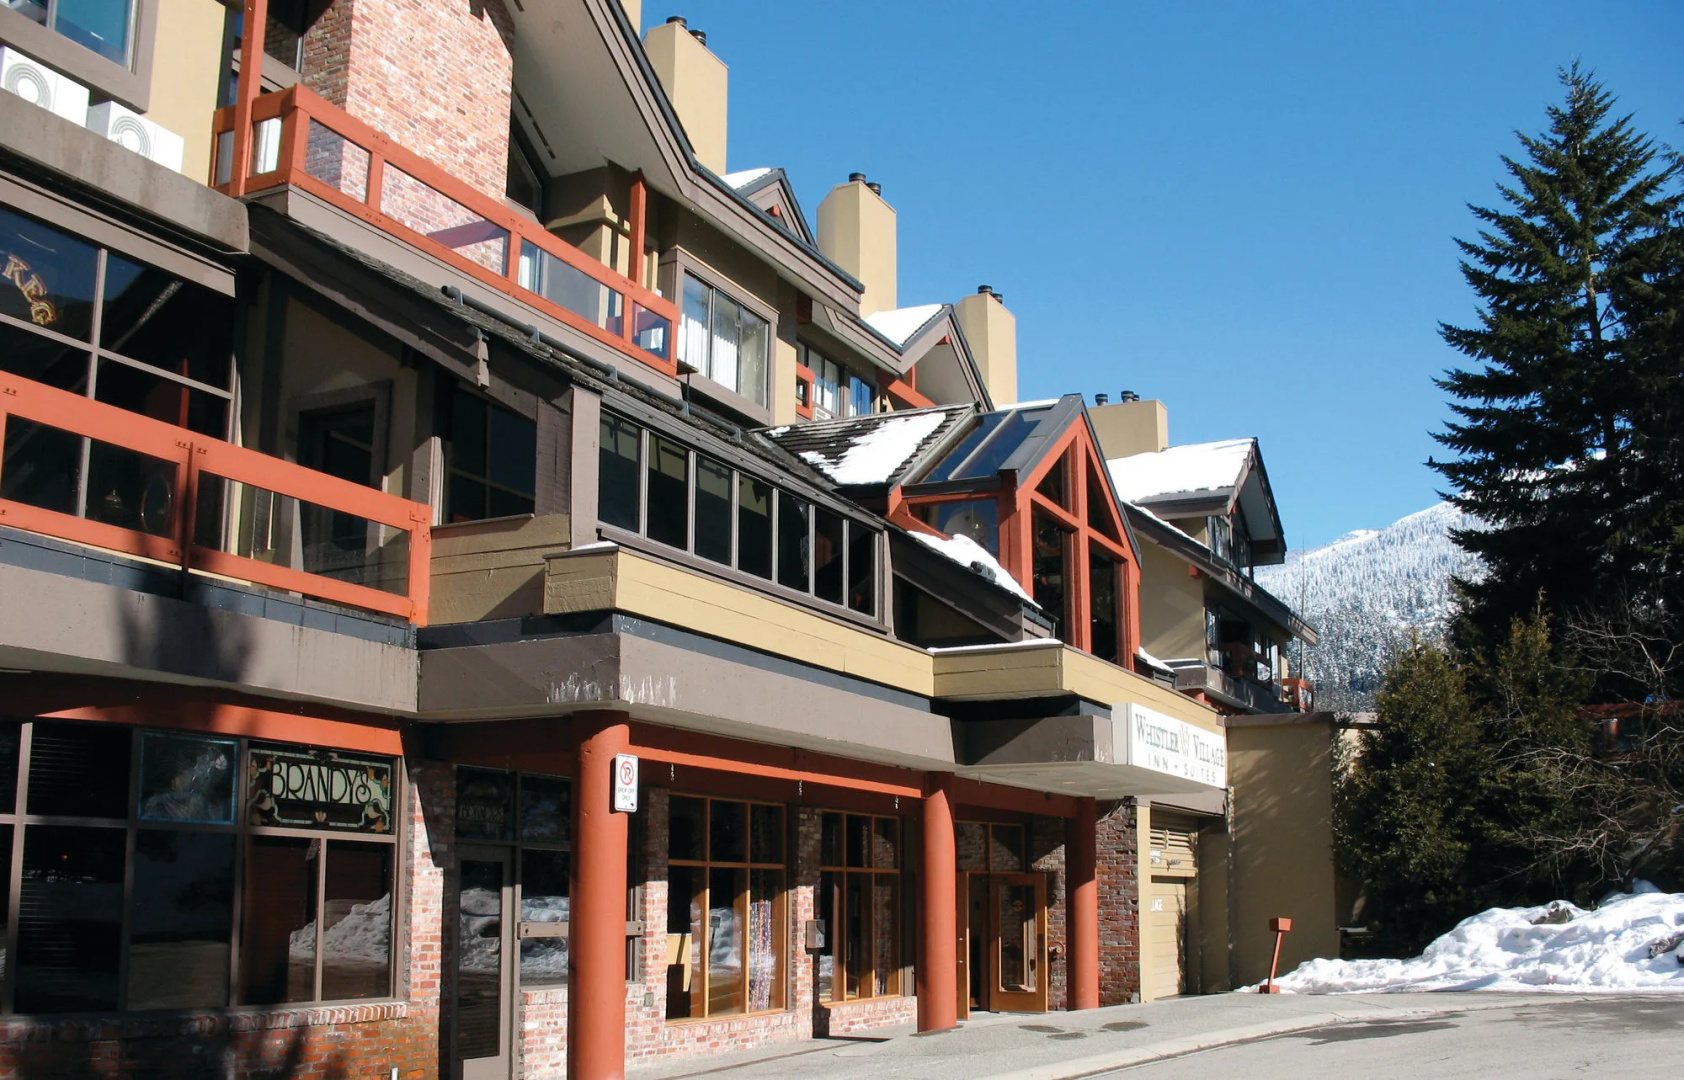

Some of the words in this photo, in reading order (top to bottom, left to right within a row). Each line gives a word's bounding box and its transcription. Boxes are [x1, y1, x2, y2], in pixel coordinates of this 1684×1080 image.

[1135, 713, 1180, 753] WHISTLER
[1193, 734, 1225, 768] VILLAGE
[271, 761, 372, 804] BRANDY'S
[1148, 754, 1168, 770] INN
[1184, 763, 1216, 783] SUITES
